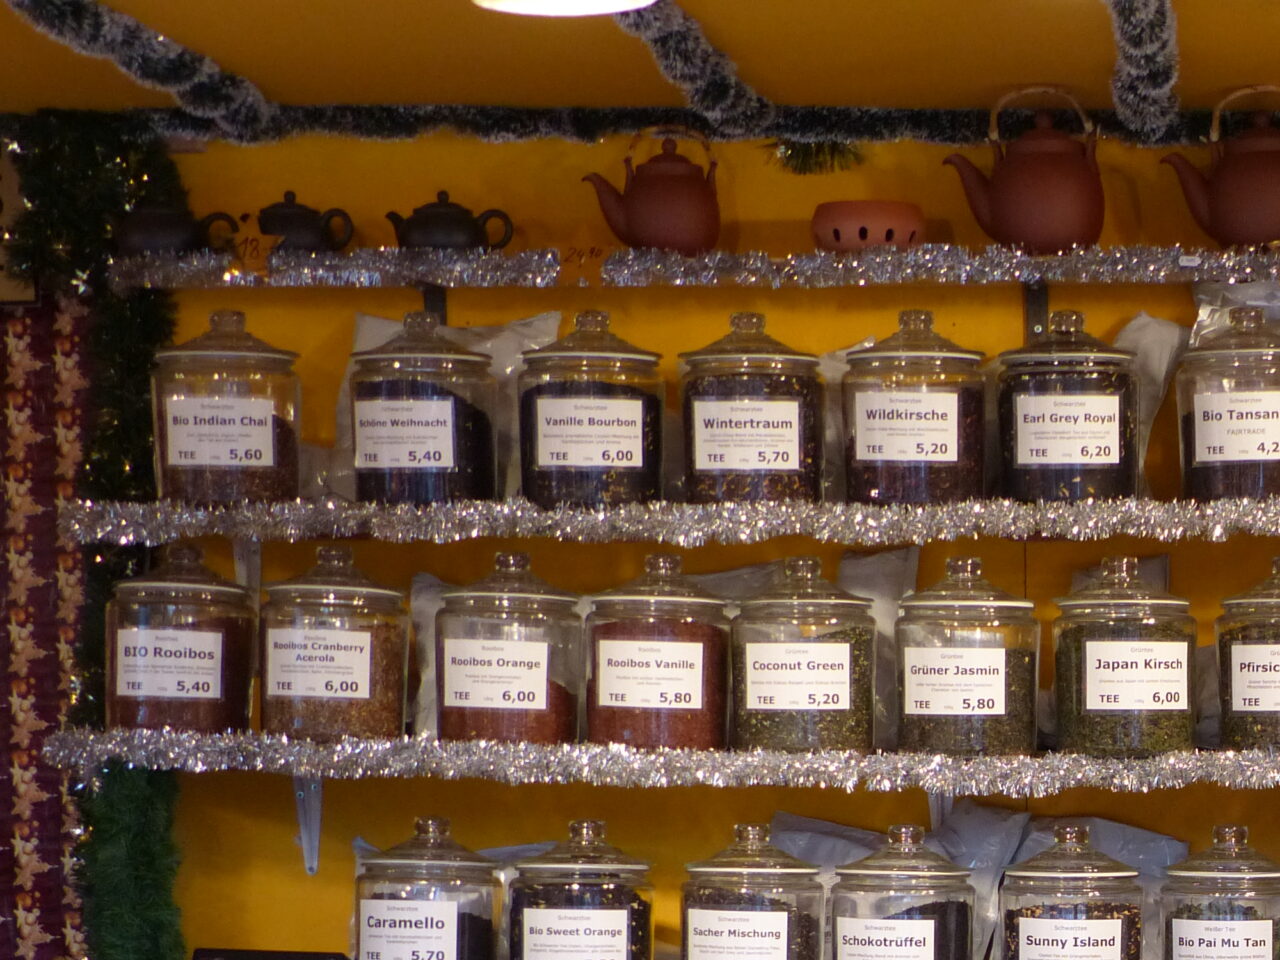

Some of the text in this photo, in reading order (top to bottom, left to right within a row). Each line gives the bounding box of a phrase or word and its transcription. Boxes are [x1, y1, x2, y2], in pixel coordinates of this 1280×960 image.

[172, 414, 268, 427] Bio Indian Chai
[545, 416, 637, 428] Vanille Bourbon
[865, 409, 948, 421] Wildkirsche
[1023, 413, 1116, 426] Earl Grey Royal
[1202, 410, 1223, 422] Bio
[389, 418, 448, 428] Weihnacht
[703, 418, 793, 430] Wintertraum
[229, 448, 263, 462] 5,60
[408, 450, 442, 464] 5,40
[549, 449, 633, 463] TEE 6,00
[866, 443, 948, 457] TEE 5,20
[1029, 445, 1111, 460] TEE 6,20
[1206, 445, 1225, 455] TEE
[707, 451, 790, 465] TEE 5,70
[123, 645, 215, 661] BIO Rooibos
[273, 640, 365, 654] Rooibos Cranberry
[295, 653, 335, 663] Acerola
[451, 656, 541, 670] Rooibos Orange
[607, 658, 695, 670] Rooibos Vanille
[752, 660, 844, 671] Coconut Green
[910, 664, 999, 676] Grüner Jasmin
[1095, 658, 1183, 673] Japan Kirsch
[176, 680, 211, 694] 5,40
[324, 680, 359, 694] 6,00
[454, 690, 536, 704] TEE 6,00
[609, 691, 692, 705] TEE 5,80
[757, 693, 840, 707] TEE 5,20
[1099, 691, 1181, 705] TEE 6,00
[1241, 697, 1260, 707] TEE
[913, 698, 995, 712] TEE 5,80
[367, 915, 445, 930] Caramello
[529, 926, 623, 939] Bio Sweet Orange
[693, 926, 781, 940] Sacher Mischung
[842, 934, 927, 948] Schokotrüffel
[1025, 934, 1116, 950] Sunny Island
[1178, 936, 1267, 948] Bio Pai Mu Tan
